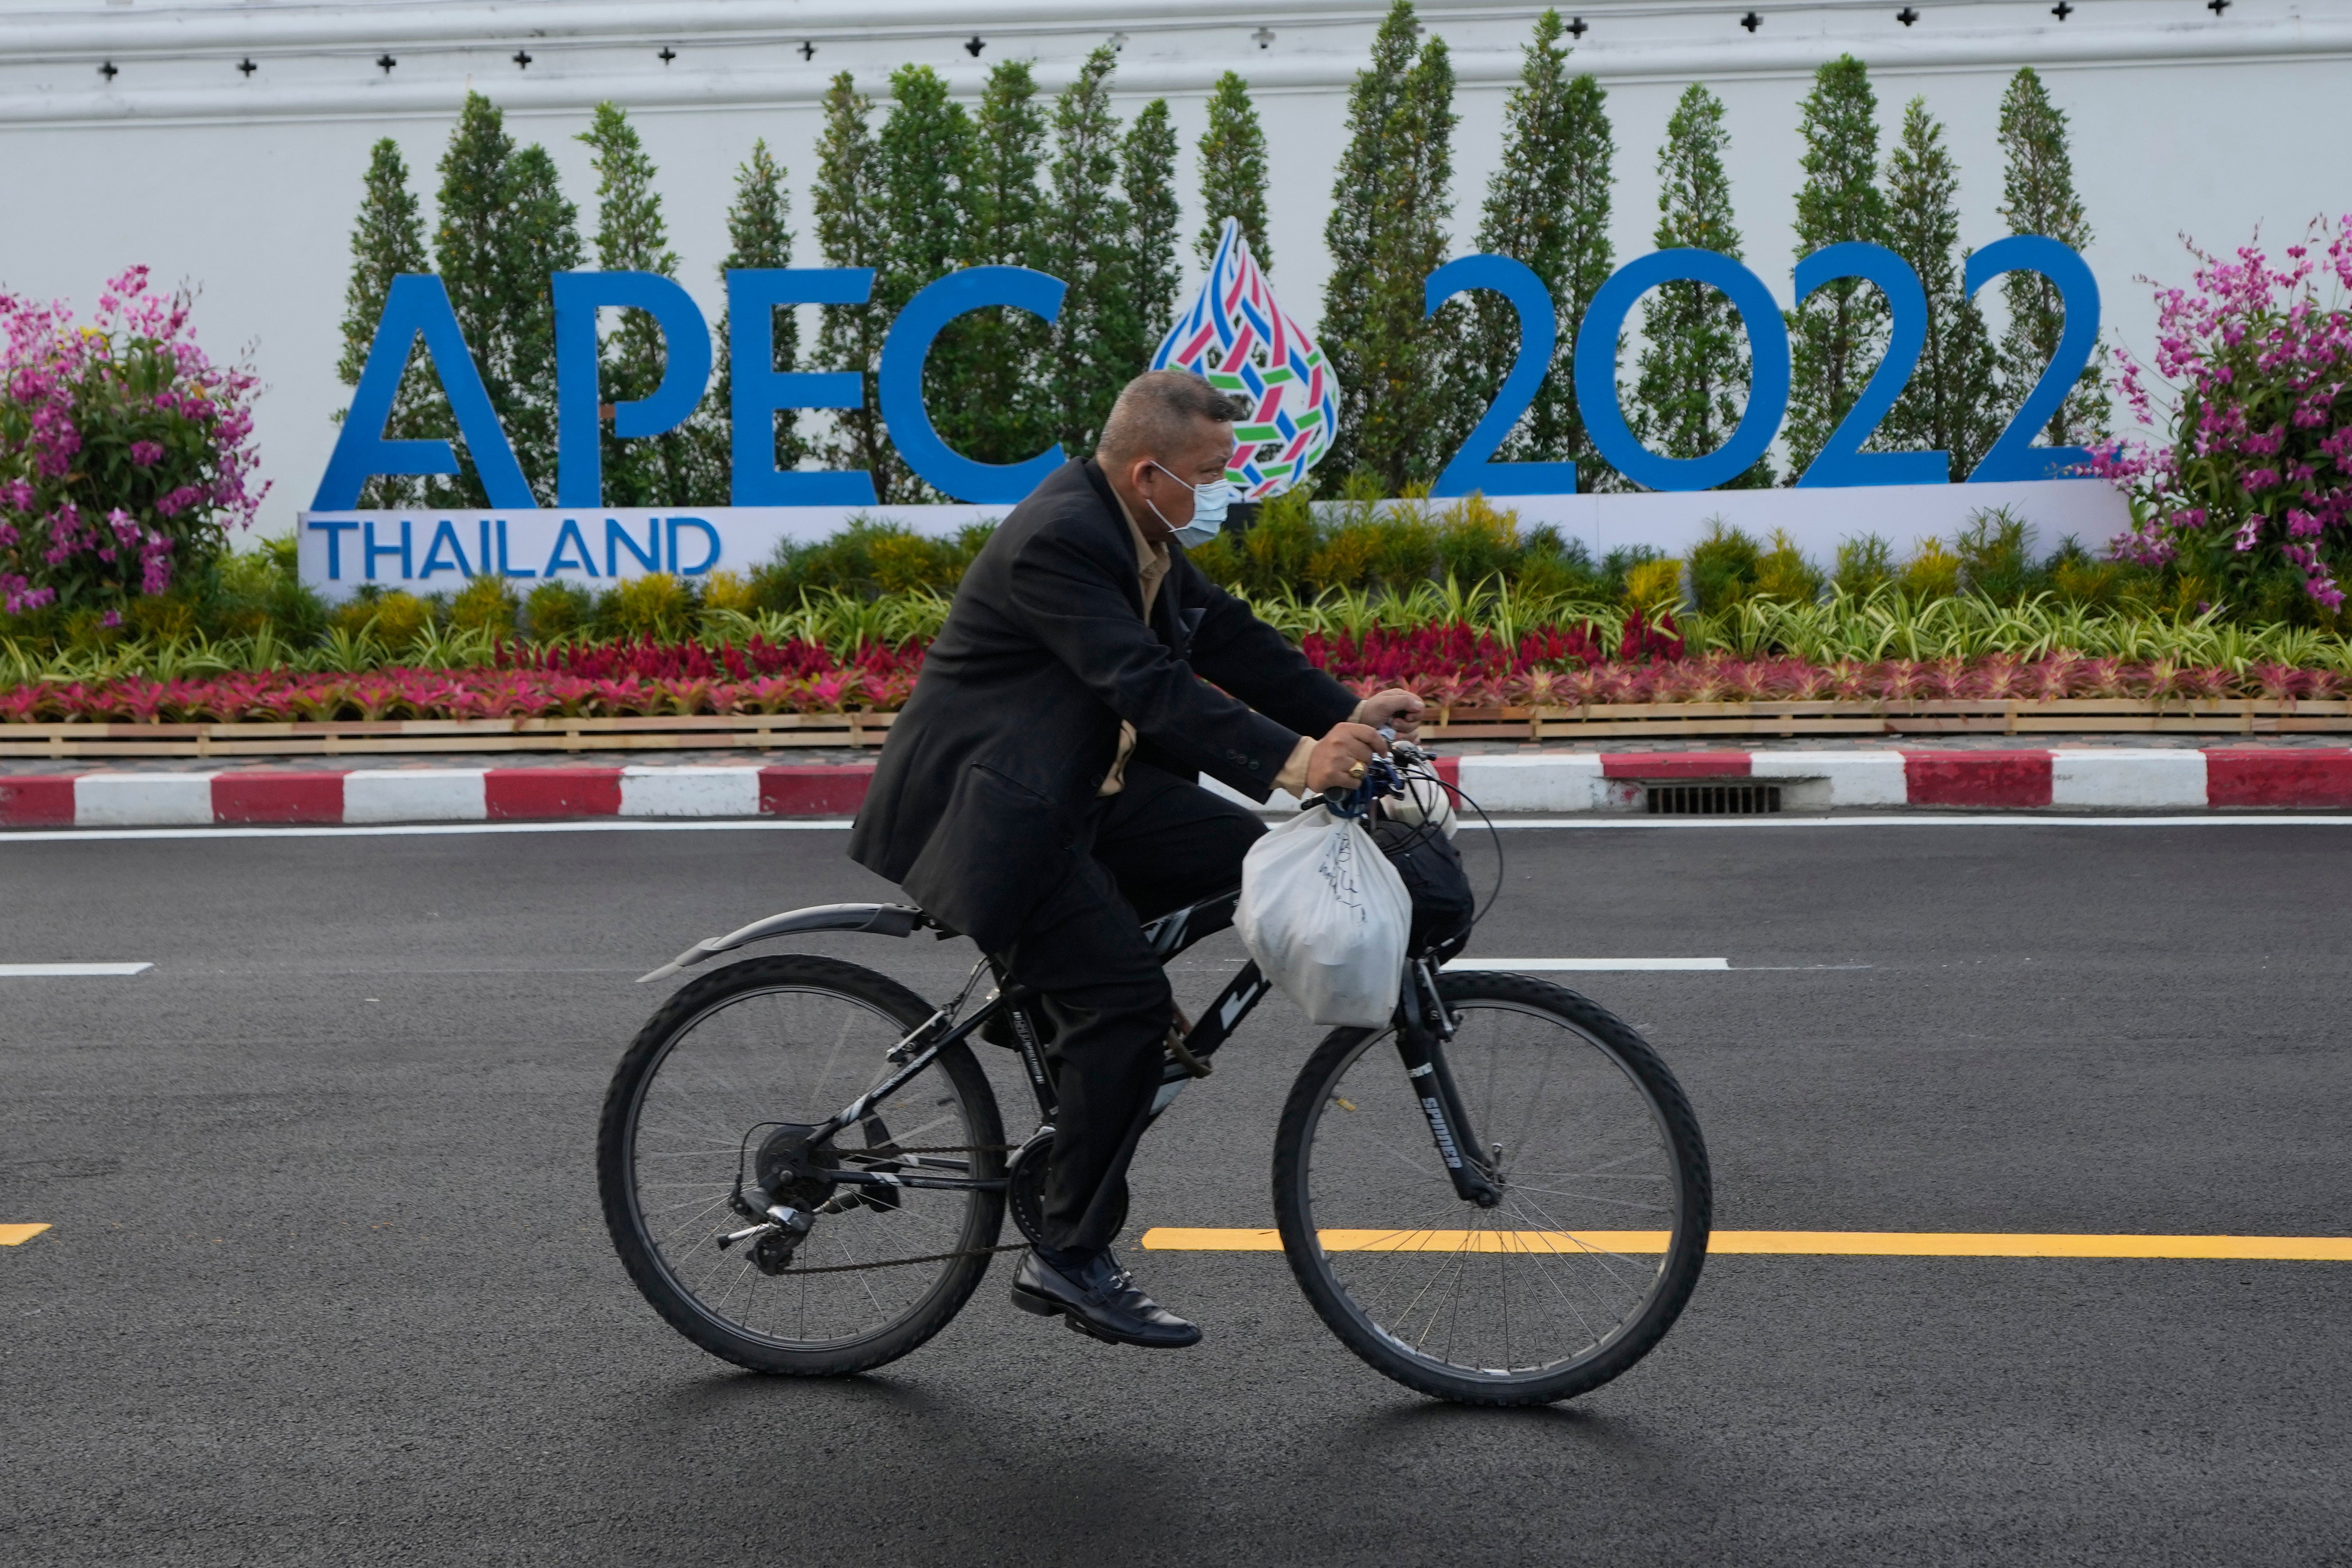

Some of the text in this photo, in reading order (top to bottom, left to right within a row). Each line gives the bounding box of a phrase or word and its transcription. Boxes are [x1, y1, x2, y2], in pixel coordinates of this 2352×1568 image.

[310, 234, 2122, 512] APEC 2022
[307, 517, 721, 579] THAILAND
[1421, 1098, 1463, 1169] SPINNER
